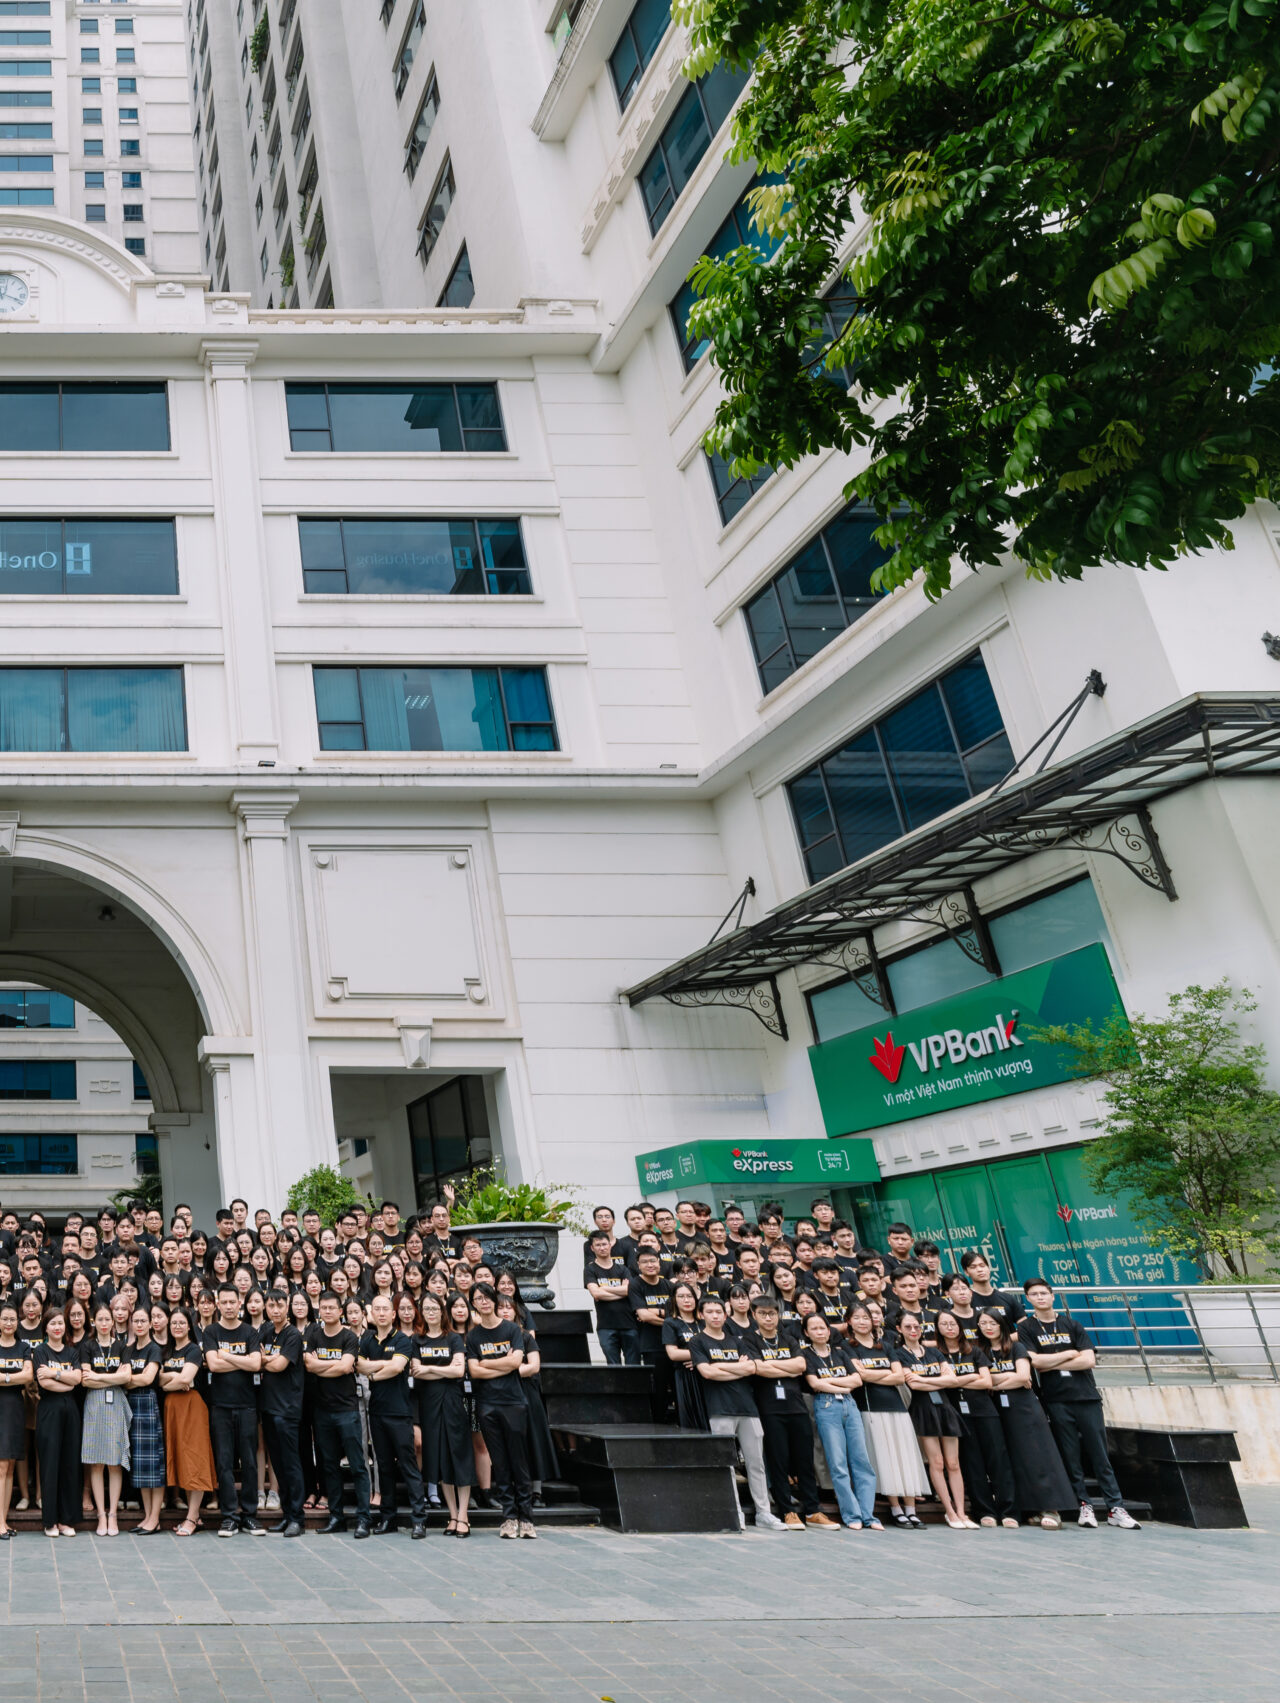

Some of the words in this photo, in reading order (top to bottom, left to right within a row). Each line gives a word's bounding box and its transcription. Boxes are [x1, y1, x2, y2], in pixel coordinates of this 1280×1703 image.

[908, 1013, 1025, 1073] VPBank
[895, 1088, 915, 1104] một
[915, 1083, 935, 1099] Việt
[937, 1077, 963, 1093] Nam
[963, 1067, 992, 1087] thịnh
[994, 1058, 1033, 1078] vượng
[1074, 1204, 1118, 1222] VPBank
[1117, 1255, 1140, 1268] TOP
[1142, 1254, 1164, 1266] 250
[317, 1348, 342, 1359] HBLAB
[420, 1347, 449, 1358] HBLAB
[710, 1349, 739, 1360] HBLAB
